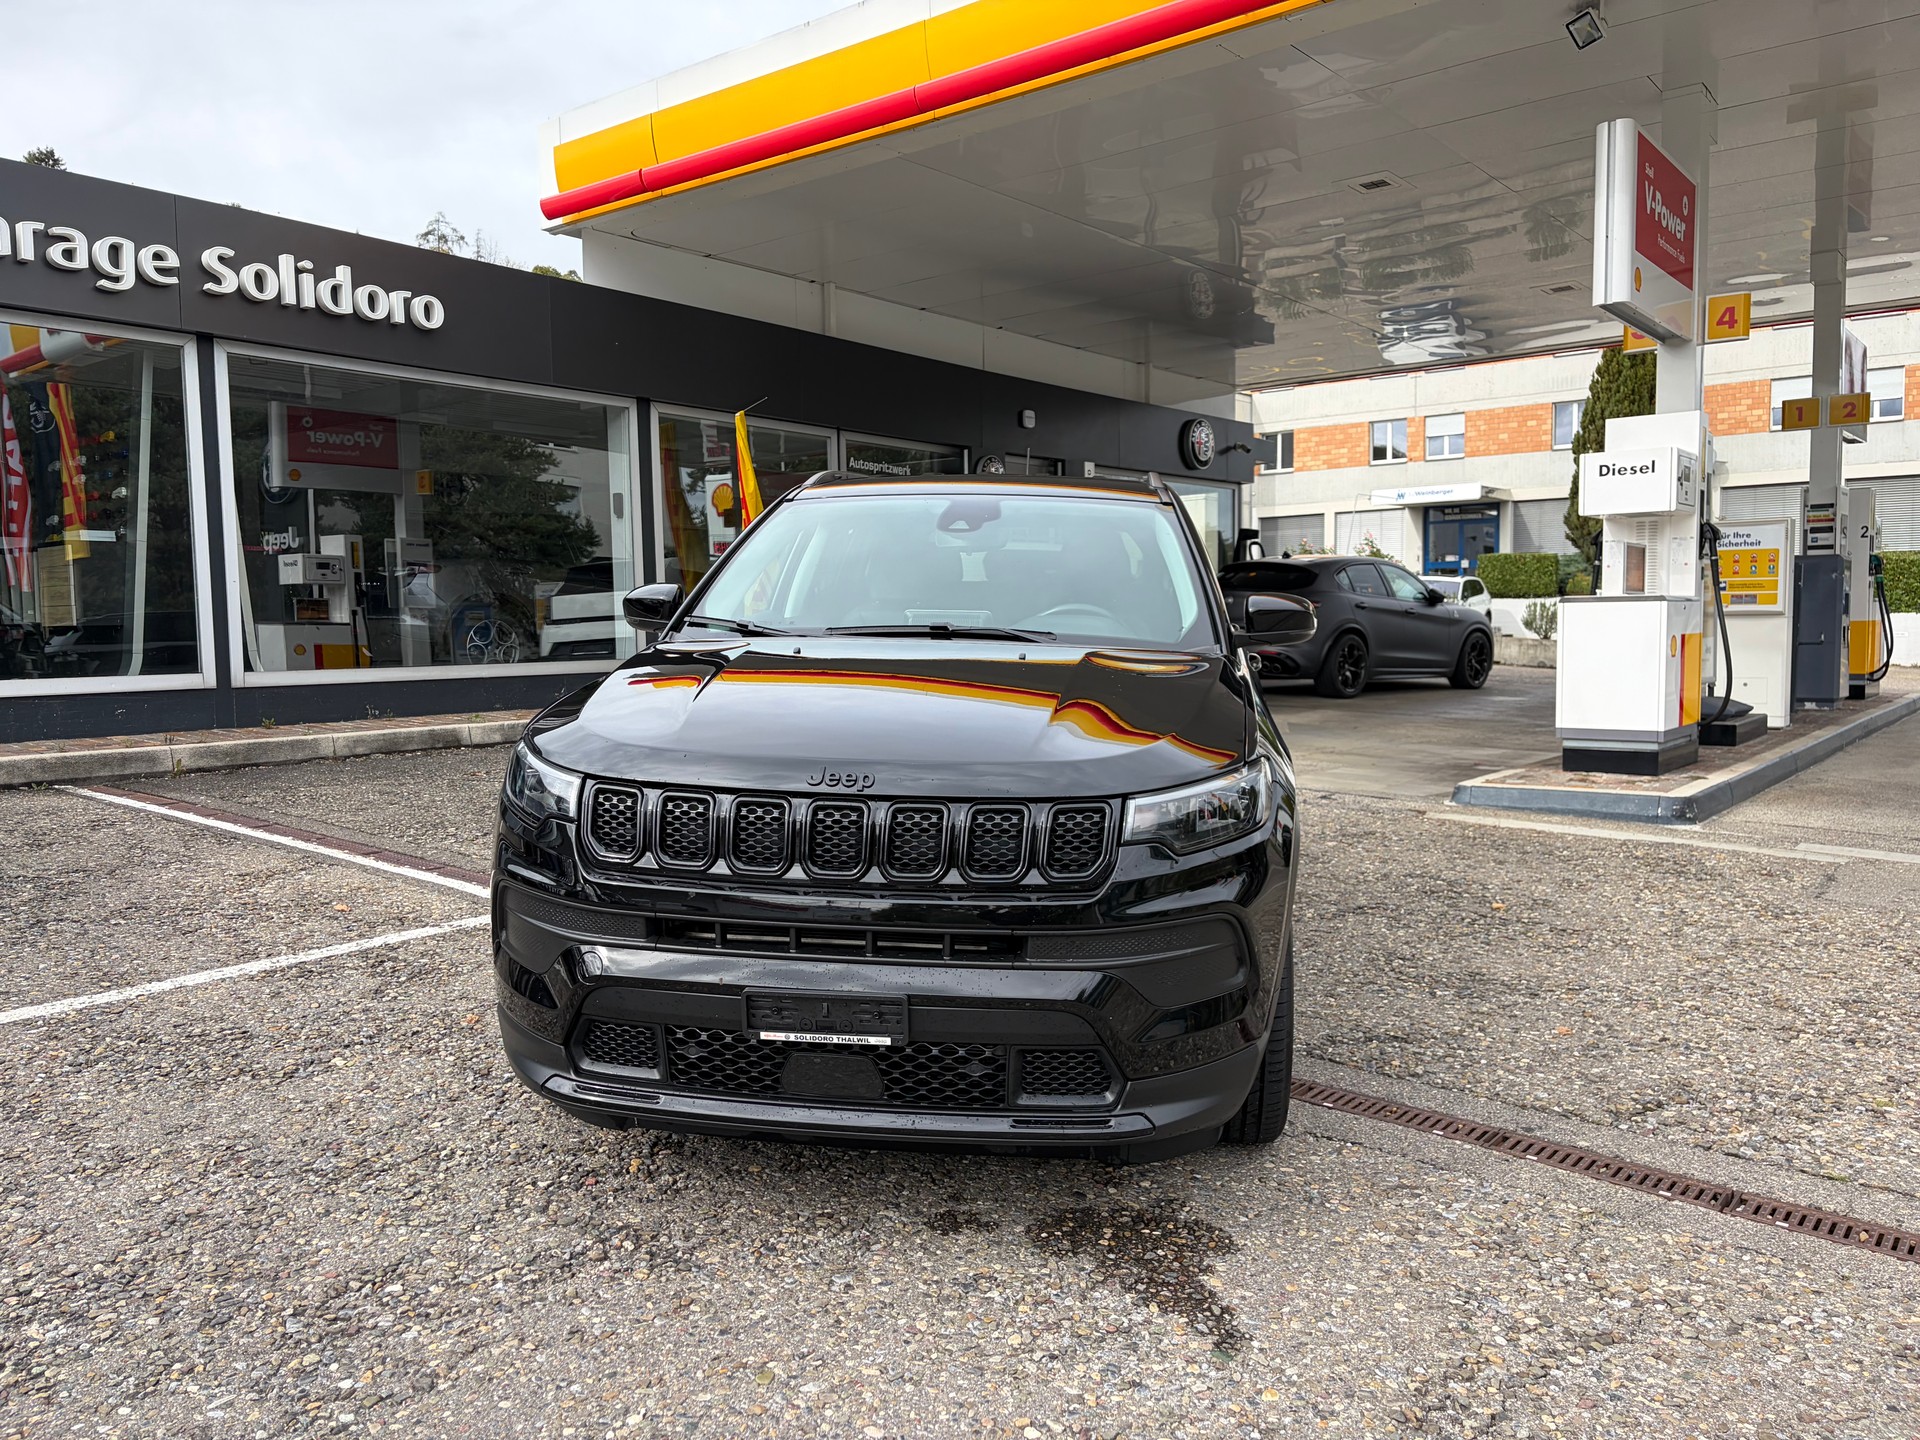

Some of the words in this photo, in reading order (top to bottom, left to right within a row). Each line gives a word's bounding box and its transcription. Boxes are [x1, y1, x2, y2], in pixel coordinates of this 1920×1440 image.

[1645, 180, 1686, 242] V-Power
[0, 216, 180, 293] rage
[201, 246, 445, 331] Solidoro
[1716, 306, 1738, 330] 4
[1795, 406, 1804, 422] 1
[1842, 402, 1857, 418] 2
[849, 456, 911, 476] Autospritzwerk
[1599, 460, 1656, 477] Diesel
[1733, 531, 1752, 539] Ihre
[1861, 525, 1869, 538] 2
[1717, 539, 1762, 548] Sicherheit
[806, 766, 876, 792] Jeep
[794, 1034, 834, 1042] SOLIDORO
[836, 1036, 872, 1044] THALWIL
